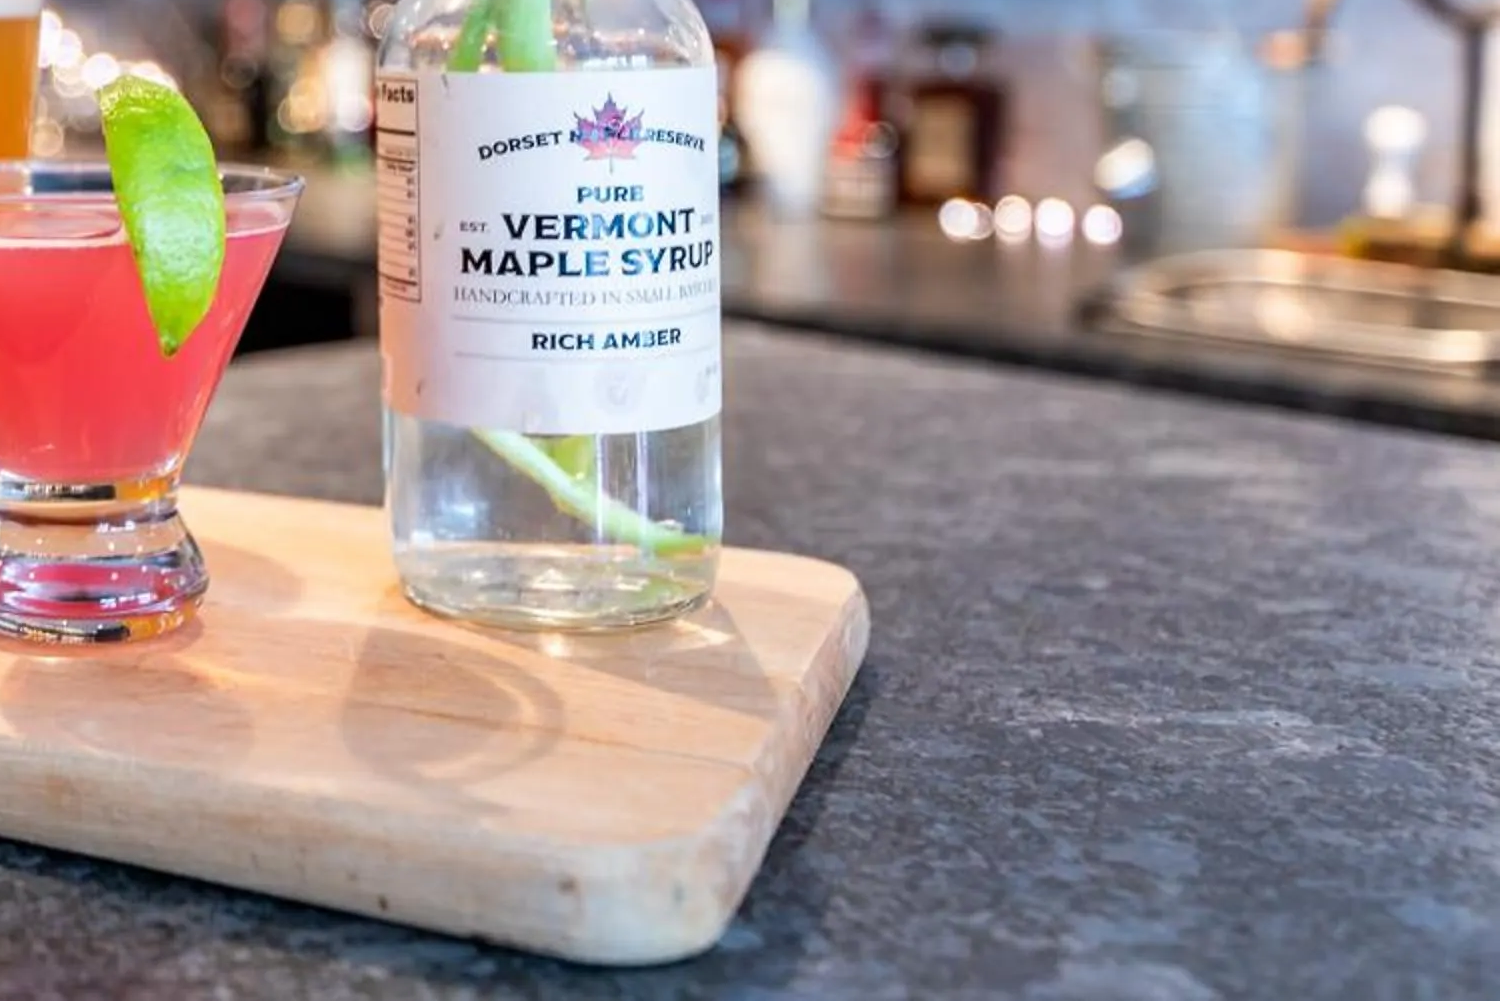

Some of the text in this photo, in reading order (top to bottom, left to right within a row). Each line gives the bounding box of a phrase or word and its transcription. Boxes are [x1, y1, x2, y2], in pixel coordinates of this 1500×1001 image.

[479, 130, 562, 160] DORSET
[646, 127, 706, 152] RESERVE
[577, 185, 644, 203] PURE
[459, 221, 489, 233] EST.
[501, 207, 695, 240] VERMONT
[461, 240, 713, 277] MAPLE SYRUP
[454, 286, 597, 306] HANDCRAFTED
[602, 291, 621, 305] IN
[531, 328, 681, 350] RICH AMBER
